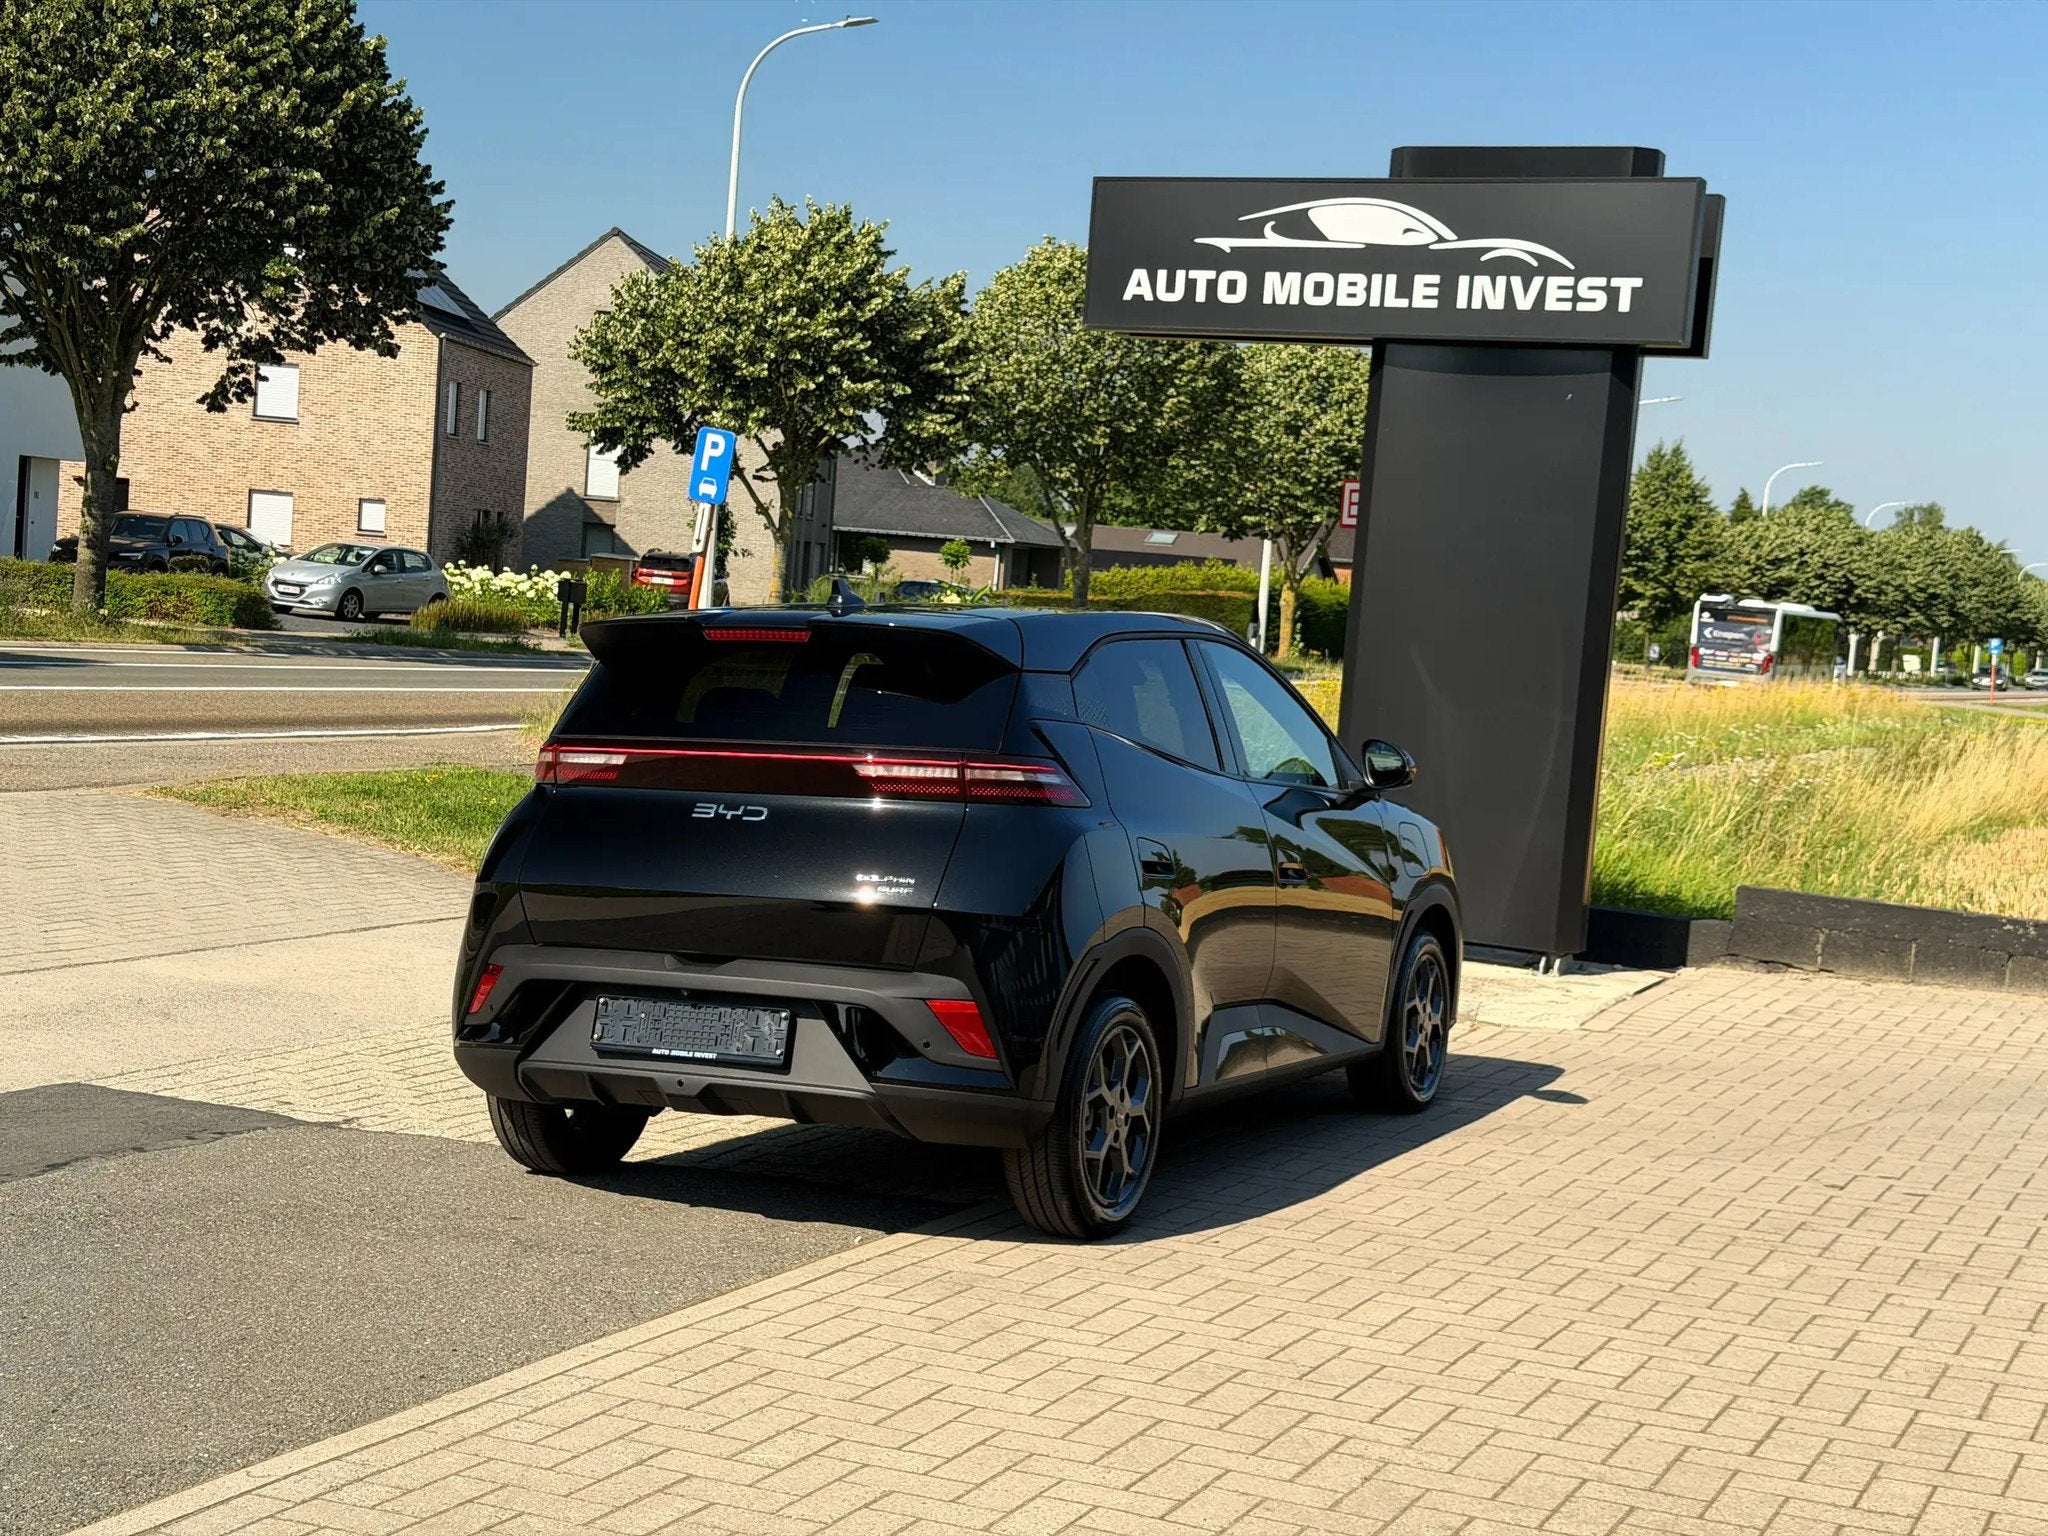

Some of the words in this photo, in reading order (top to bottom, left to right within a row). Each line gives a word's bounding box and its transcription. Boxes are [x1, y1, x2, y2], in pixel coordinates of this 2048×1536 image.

[1122, 268, 1248, 304] AUTO
[1262, 271, 1441, 309] MOBILE
[1455, 274, 1643, 313] INVEST
[701, 432, 726, 471] P
[691, 802, 769, 821] BYD
